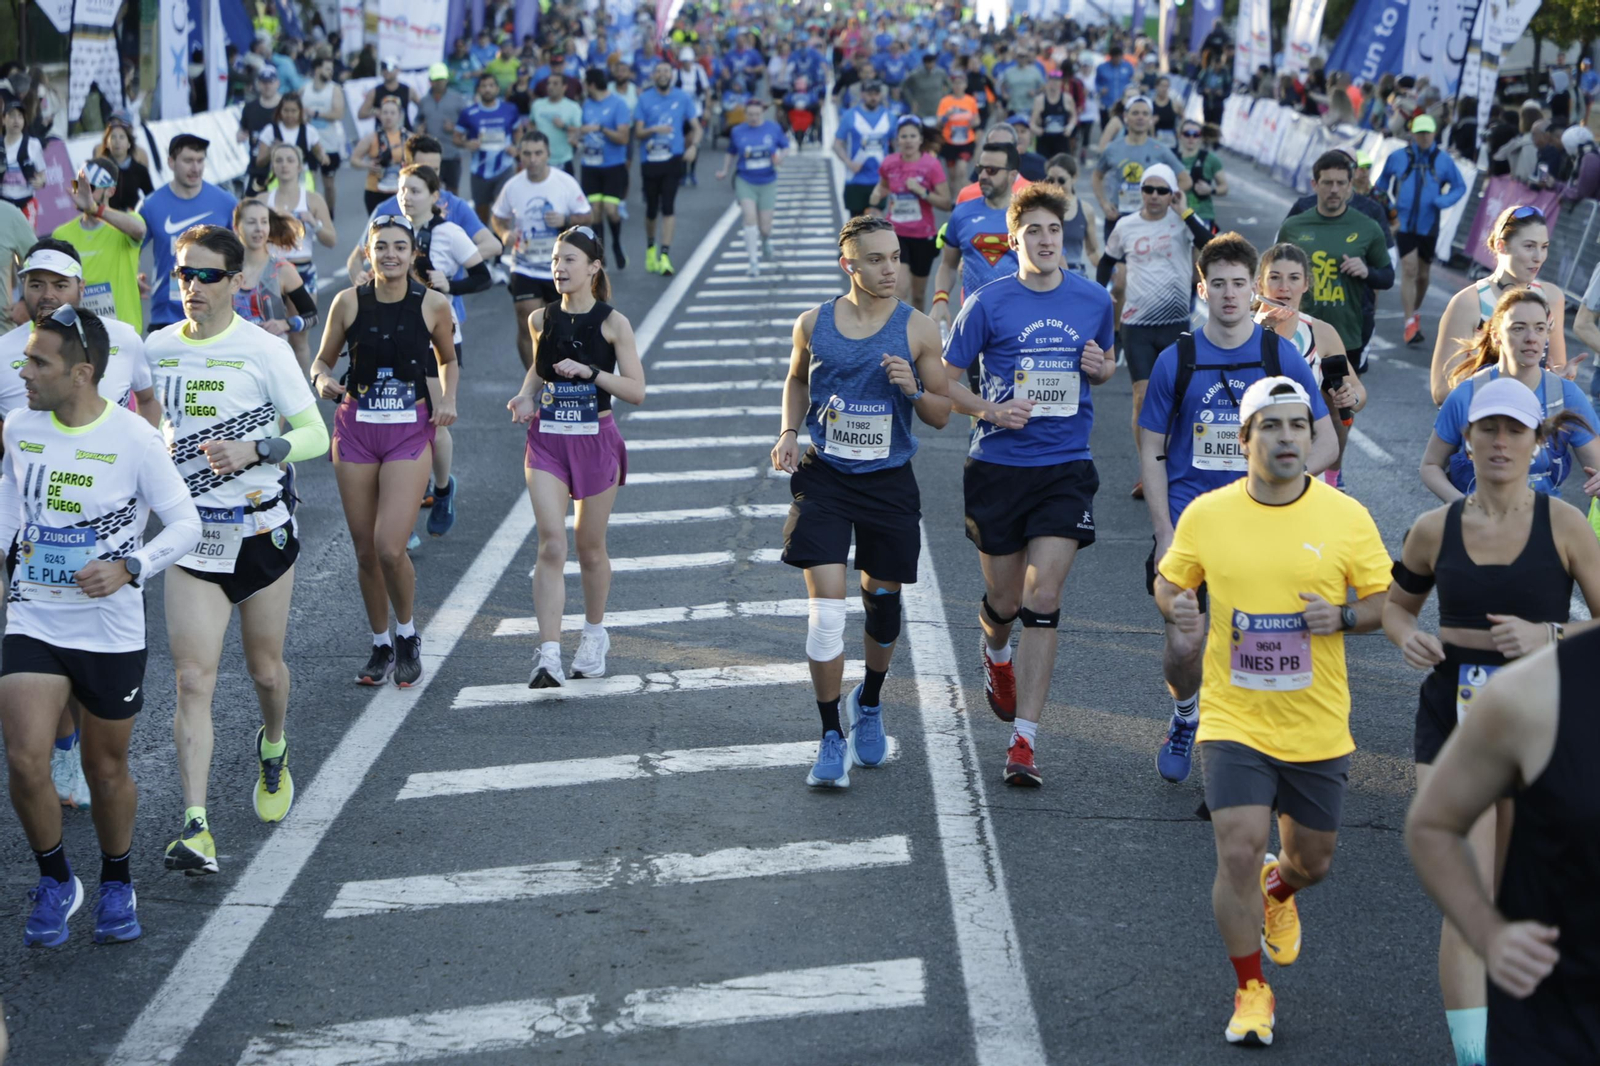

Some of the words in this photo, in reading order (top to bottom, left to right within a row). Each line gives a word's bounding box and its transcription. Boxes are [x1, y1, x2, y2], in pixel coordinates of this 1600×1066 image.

[1374, 7, 1398, 37] to
[84, 285, 107, 295] URICH
[95, 306, 115, 316] TIAN
[1017, 319, 1045, 343] CARING
[1046, 318, 1064, 329] FOR
[1063, 324, 1080, 342] LIFE
[1037, 360, 1073, 369] ZURICH
[186, 380, 225, 392] CARROS
[557, 384, 590, 393] ZURICH
[1036, 378, 1060, 387] 11237
[1229, 379, 1246, 390] FOR
[375, 387, 398, 395] 1172
[1027, 389, 1067, 402] PADDY
[185, 393, 196, 403] DE
[368, 397, 404, 410] LAURA
[558, 400, 579, 408] 14171
[184, 405, 217, 417] FUEGO
[848, 403, 885, 414] ZURICH
[554, 410, 582, 421] ELEN
[1217, 413, 1239, 421] ZUR
[846, 420, 871, 430] 11982
[832, 428, 884, 445] MARCUS
[50, 471, 93, 488] CARROS
[47, 485, 61, 497] DE
[47, 498, 81, 513] FUEGO
[43, 531, 86, 543] ZURICH
[202, 529, 221, 540] 0443
[193, 541, 225, 556] IEGO
[44, 553, 66, 565] 6243
[28, 565, 38, 581] E.
[42, 568, 76, 584] PLAZ
[1254, 617, 1302, 629] ZURICH
[1256, 641, 1281, 652] 9604
[1240, 653, 1274, 671] INES
[1279, 655, 1300, 671] PB
